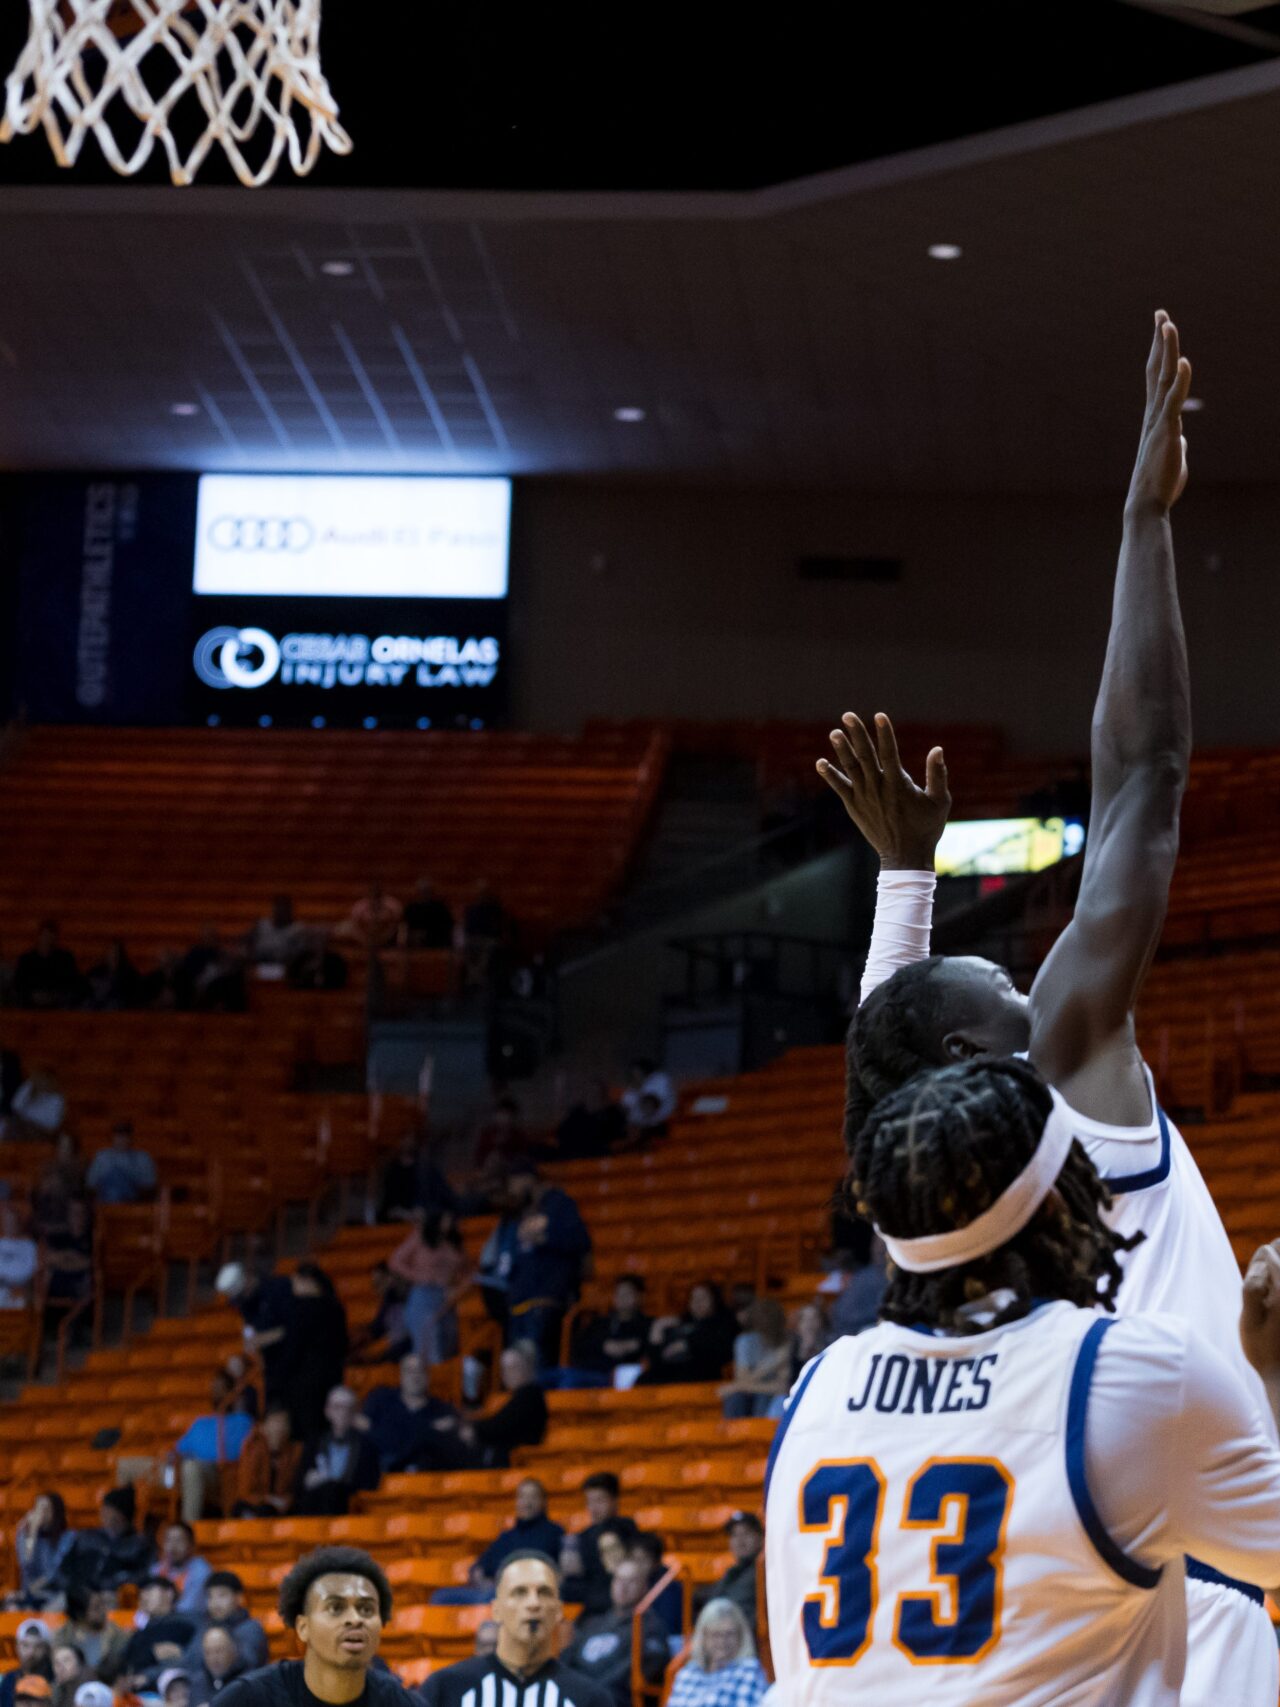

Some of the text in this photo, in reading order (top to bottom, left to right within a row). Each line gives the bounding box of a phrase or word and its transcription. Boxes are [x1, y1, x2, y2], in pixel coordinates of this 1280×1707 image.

[281, 664, 497, 688] INJURY LAW
[848, 1353, 998, 1415] JONES
[798, 1456, 1016, 1668] 33
